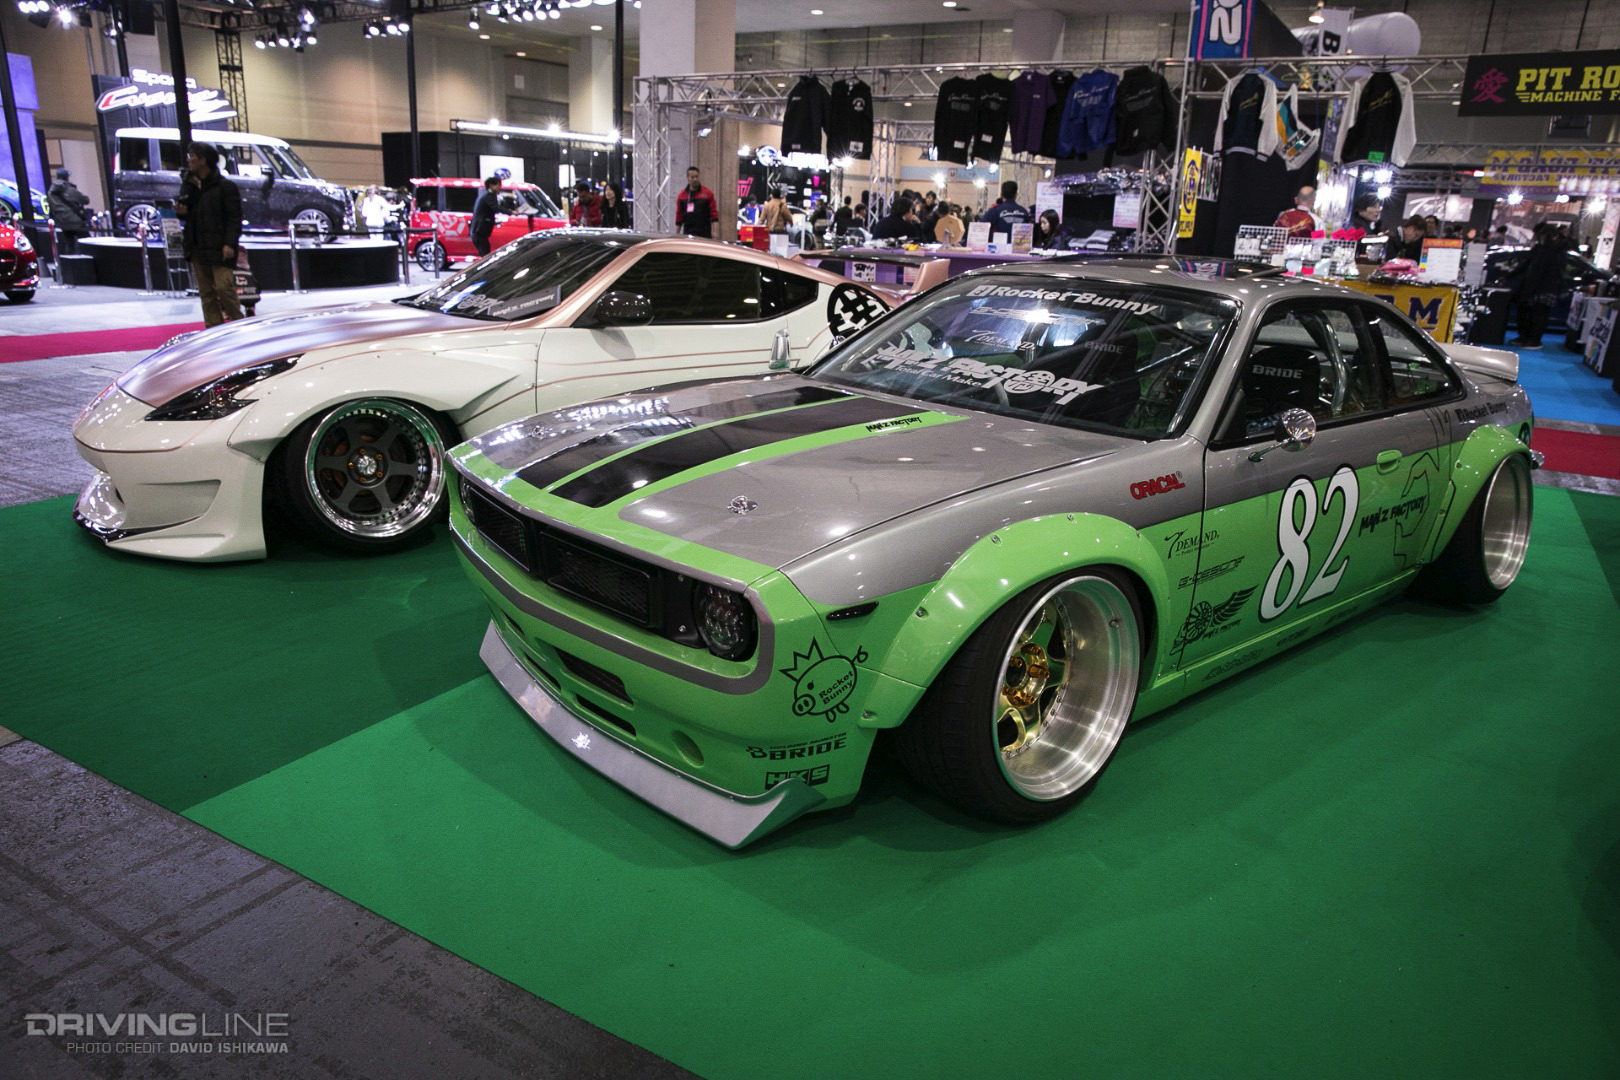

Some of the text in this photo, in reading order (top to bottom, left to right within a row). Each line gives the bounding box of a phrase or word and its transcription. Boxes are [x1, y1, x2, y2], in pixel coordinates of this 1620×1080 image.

[1471, 68, 1509, 103] 愛
[1516, 67, 1572, 91] PIT
[1530, 90, 1603, 103] MACHINE
[991, 286, 1158, 315] Rocket Bunny
[895, 365, 921, 376] Total
[920, 368, 943, 379] Car
[1252, 364, 1304, 379] BRIDE
[1258, 463, 1360, 623] 82
[818, 670, 854, 699] Rocket
[822, 679, 854, 705] Bunny
[769, 737, 847, 760] BRIDE
[765, 764, 830, 790] HKS
